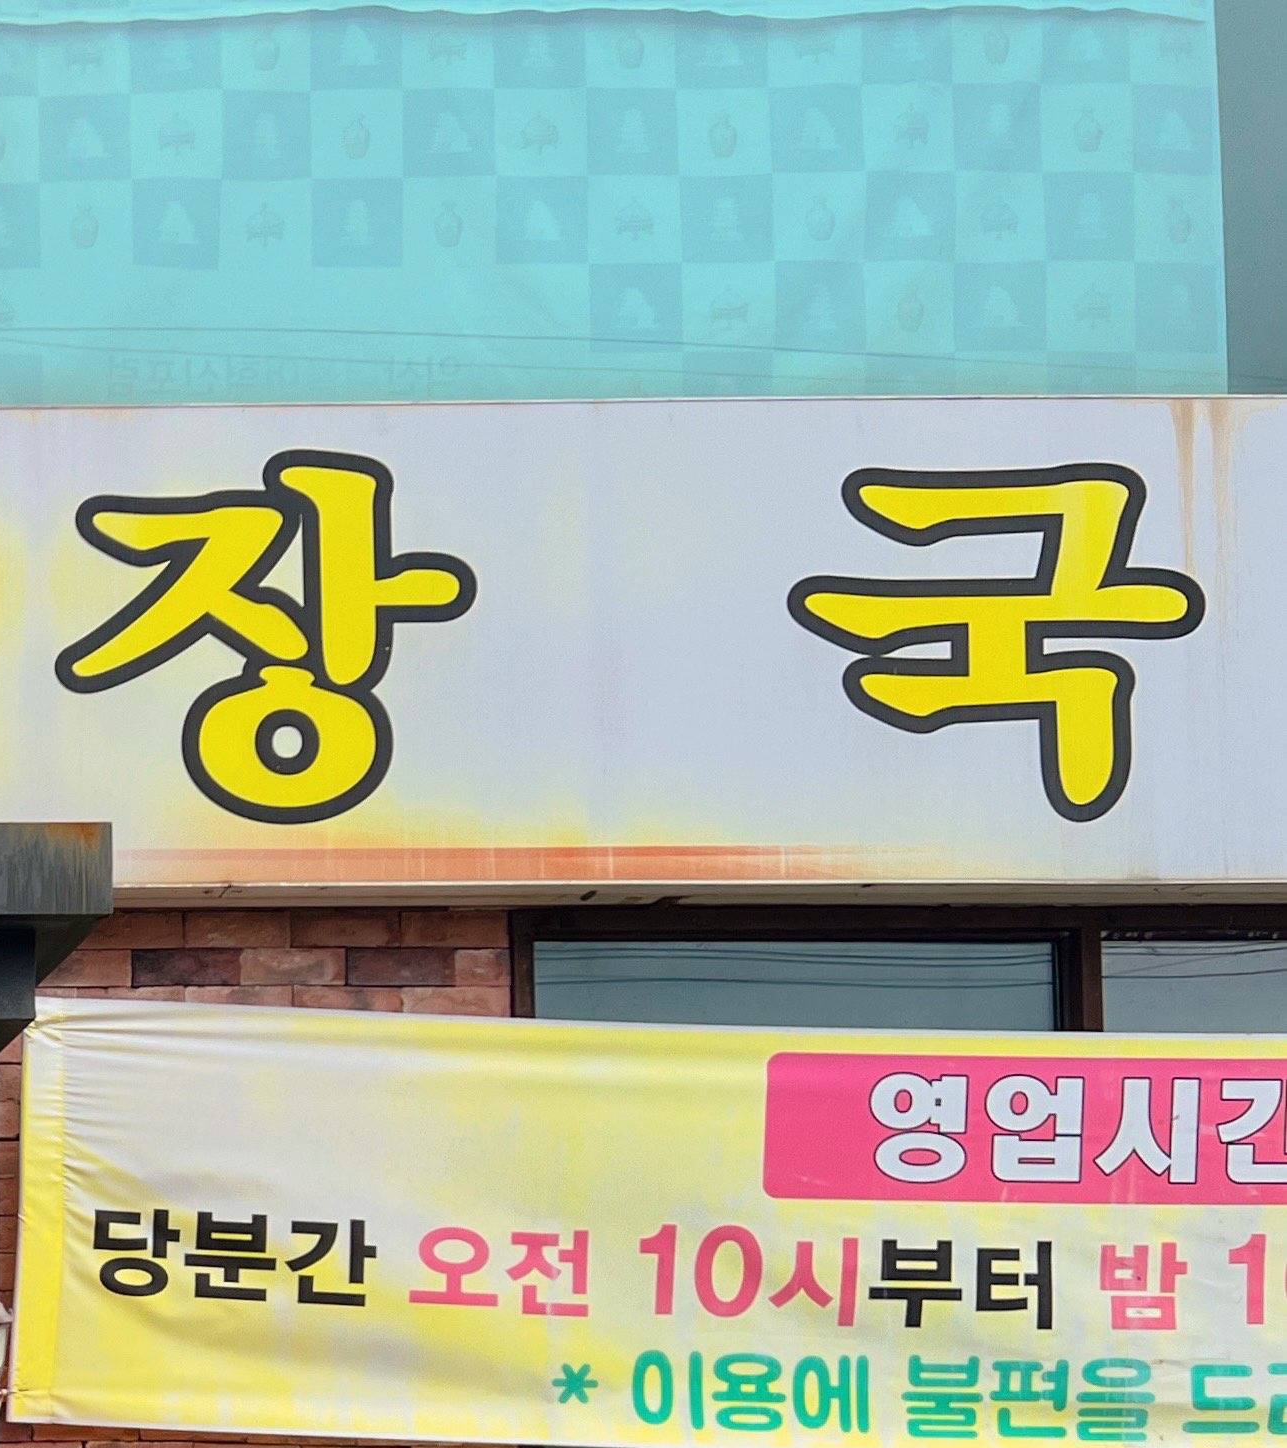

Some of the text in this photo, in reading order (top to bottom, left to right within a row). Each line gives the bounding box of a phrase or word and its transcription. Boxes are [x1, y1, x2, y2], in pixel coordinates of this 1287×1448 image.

[91, 1207, 1287, 1331] 당분간 오전 10시부터 밤 1
[632, 1348, 871, 1434] 이용에
[901, 1354, 1156, 1443] 불편을
